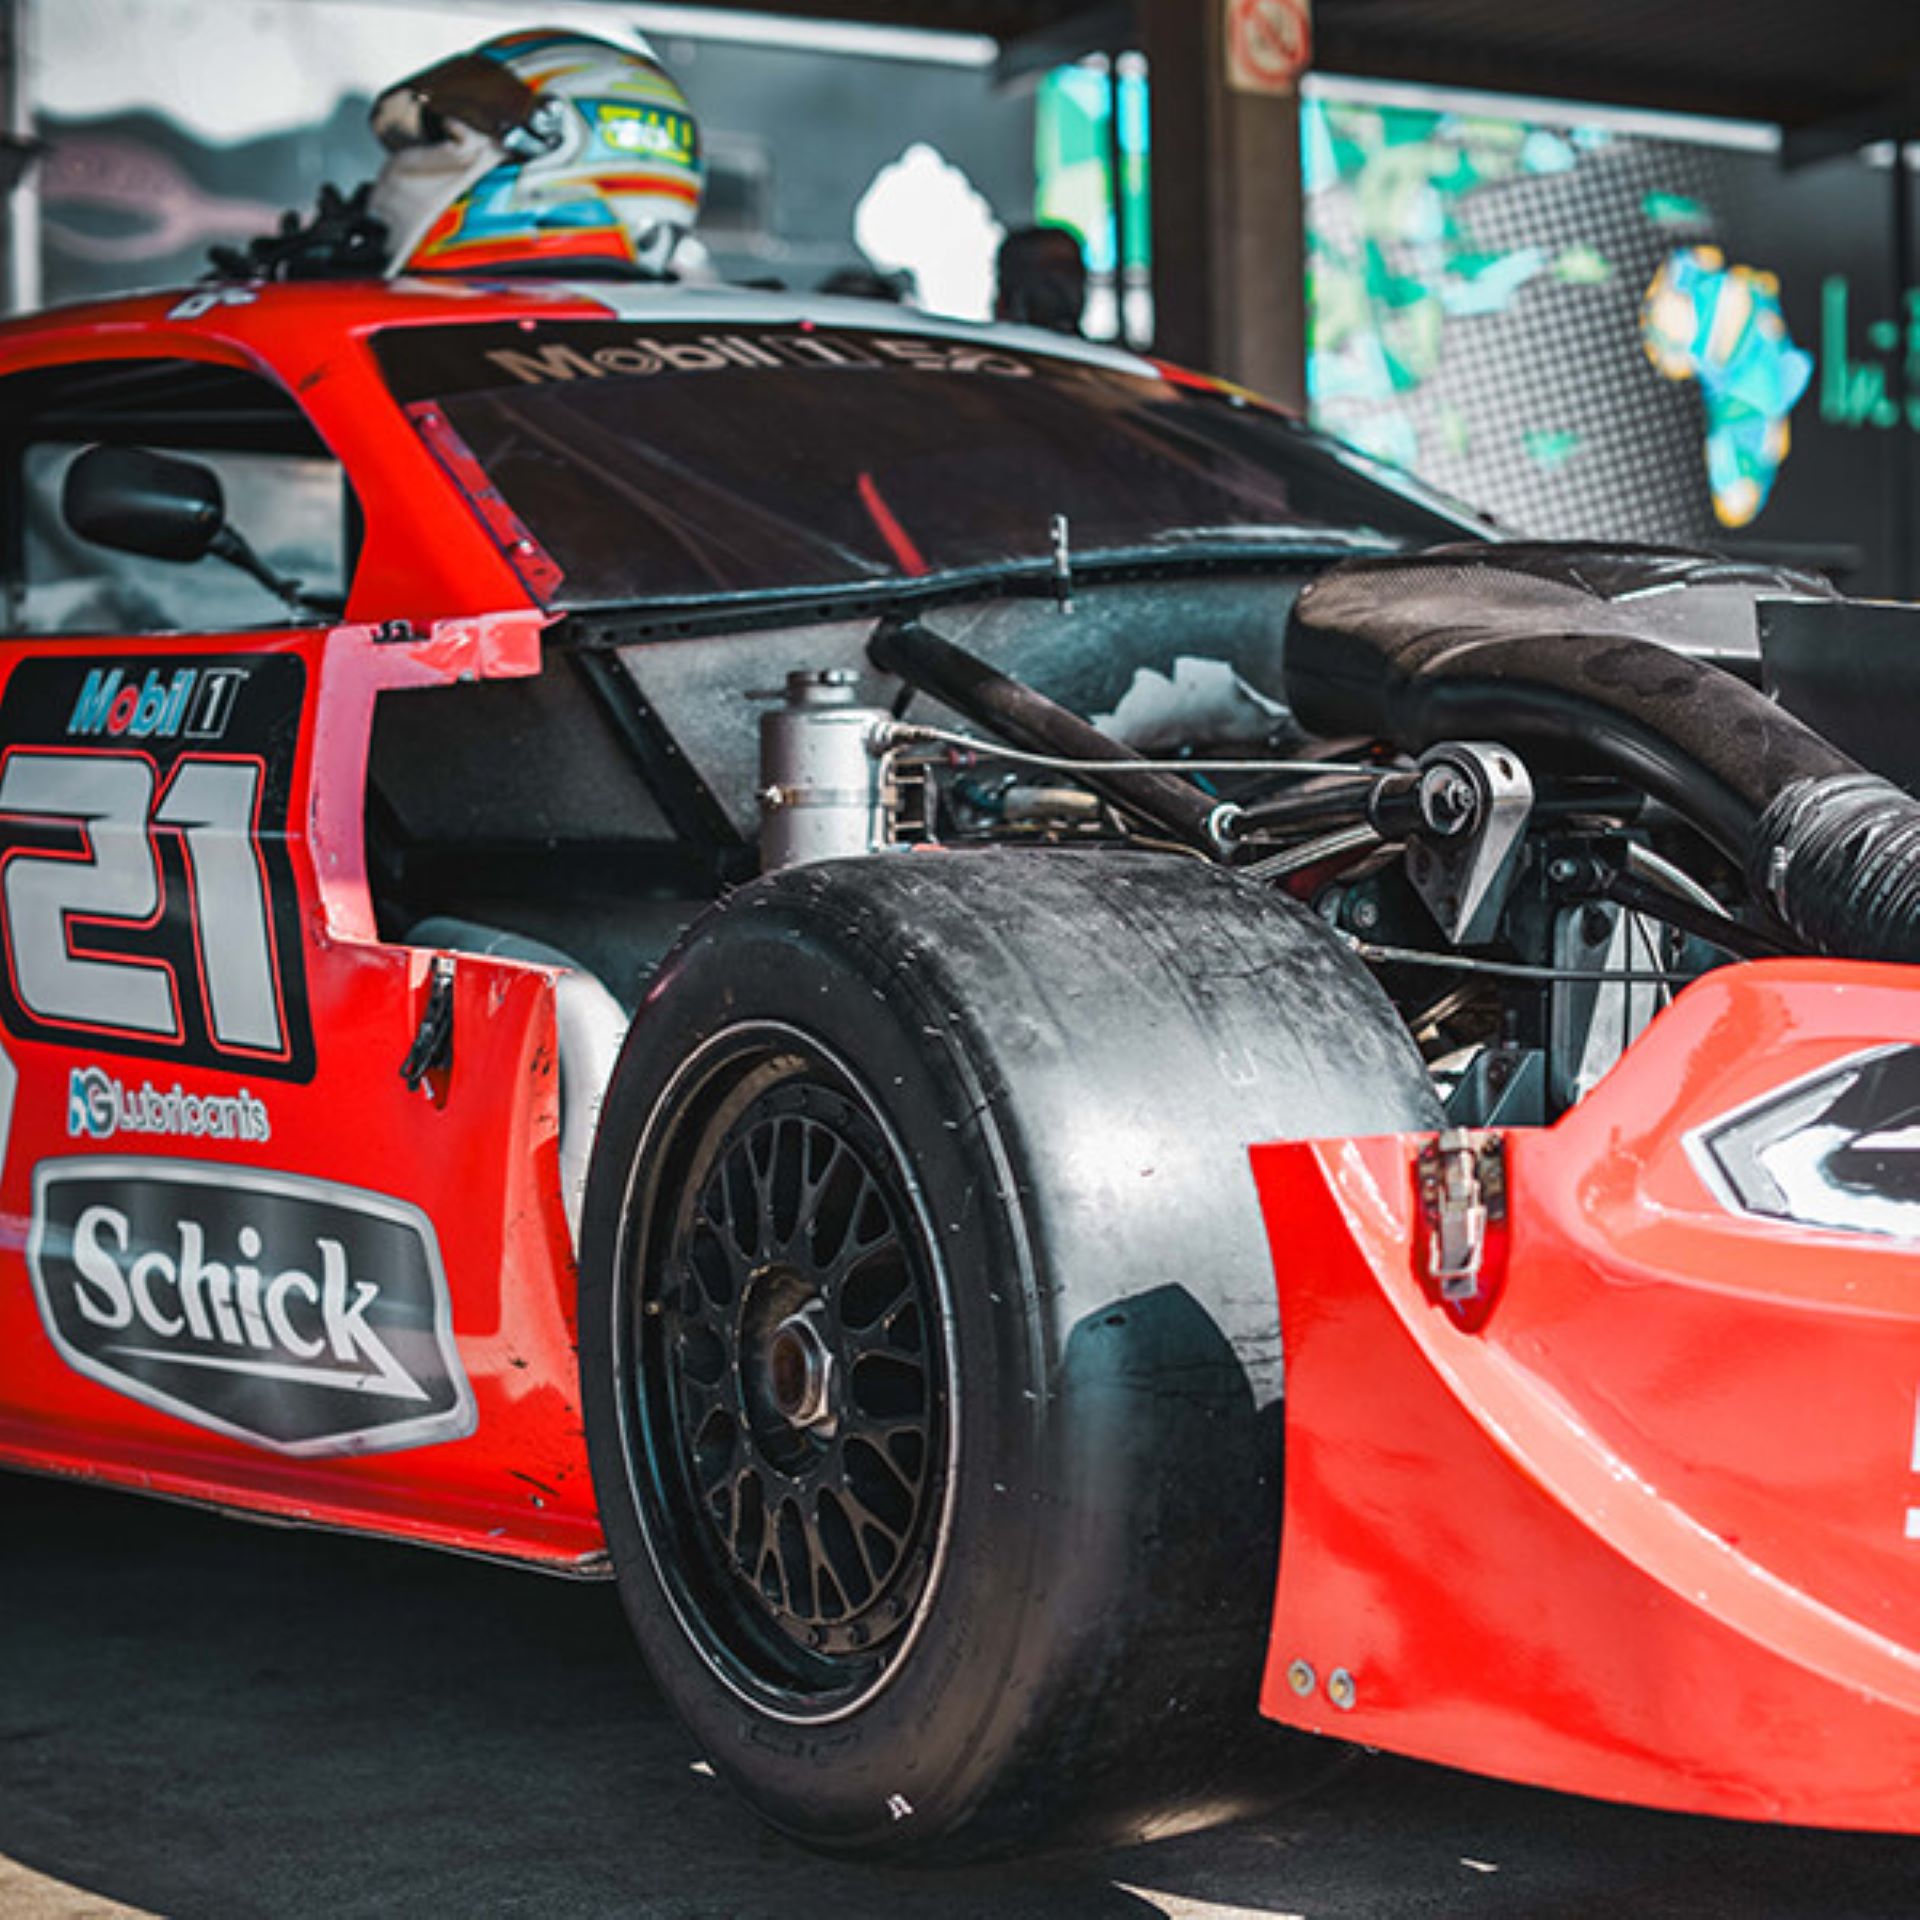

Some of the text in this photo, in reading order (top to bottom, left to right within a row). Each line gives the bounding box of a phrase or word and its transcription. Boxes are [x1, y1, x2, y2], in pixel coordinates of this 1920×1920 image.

[486, 336, 782, 386] Mobil
[67, 667, 197, 738] Mobil
[0, 747, 288, 1060] 21
[72, 1204, 428, 1392] Schick
